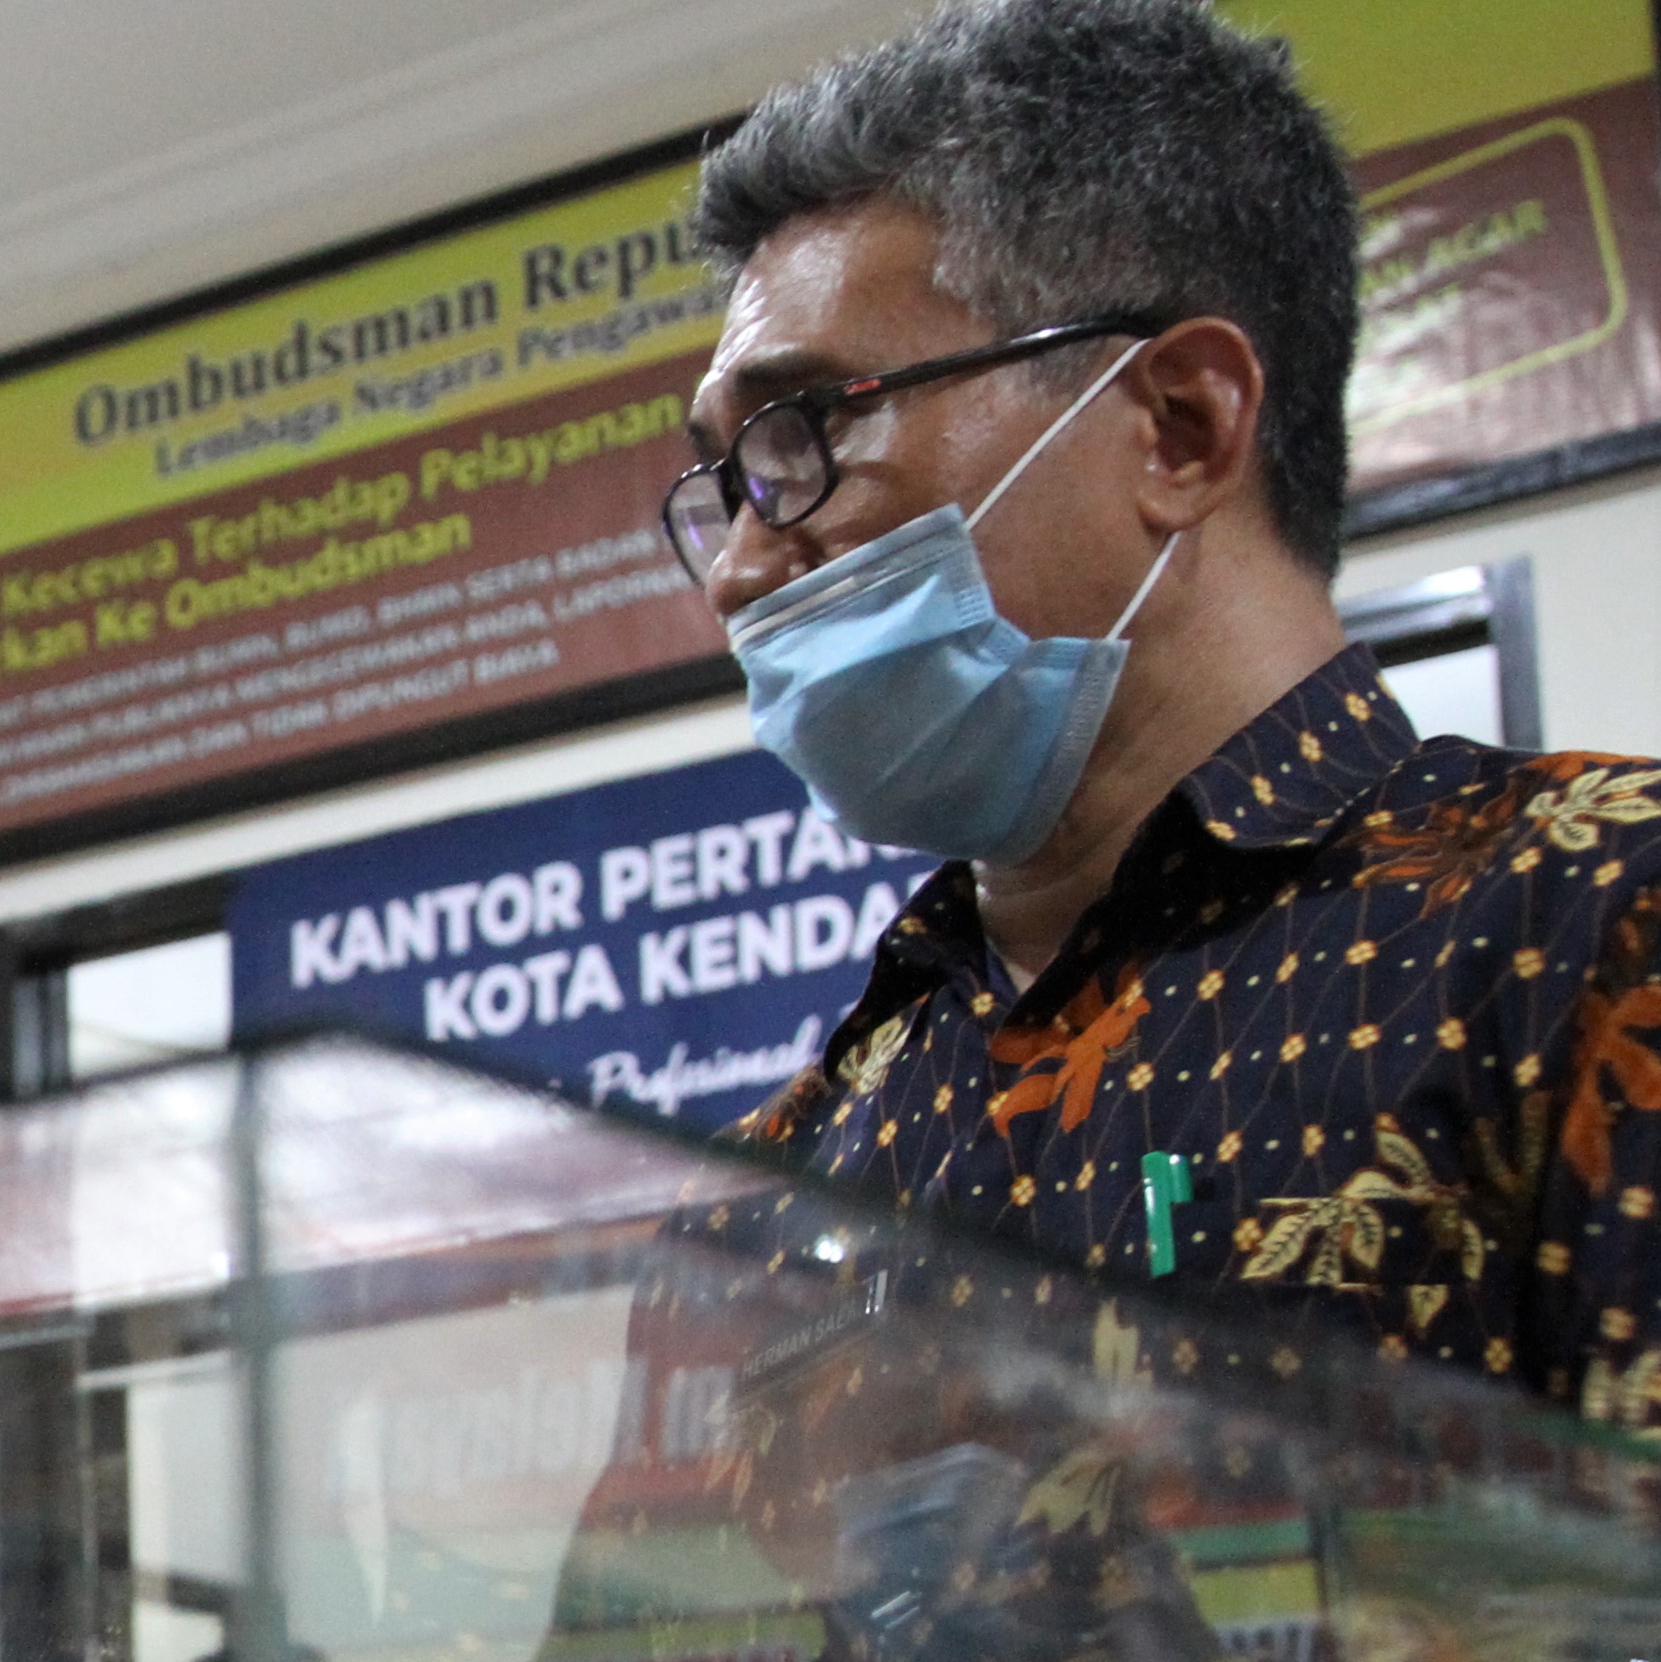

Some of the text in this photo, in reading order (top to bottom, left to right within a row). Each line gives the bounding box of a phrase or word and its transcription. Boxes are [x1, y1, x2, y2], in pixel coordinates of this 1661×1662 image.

[74, 280, 498, 446] Ombudsman
[155, 400, 342, 477] Lembaga
[355, 350, 503, 413] Negara
[0, 537, 179, 613] Kecewa
[188, 470, 411, 565] Terhadap
[419, 393, 681, 498] Pelayanan
[95, 598, 157, 644] Ke
[164, 512, 471, 629] Ombudsman
[290, 859, 584, 989] KANTOR
[424, 868, 935, 1042] KOTA KENDA
[742, 1324, 812, 1382] HERMAN
